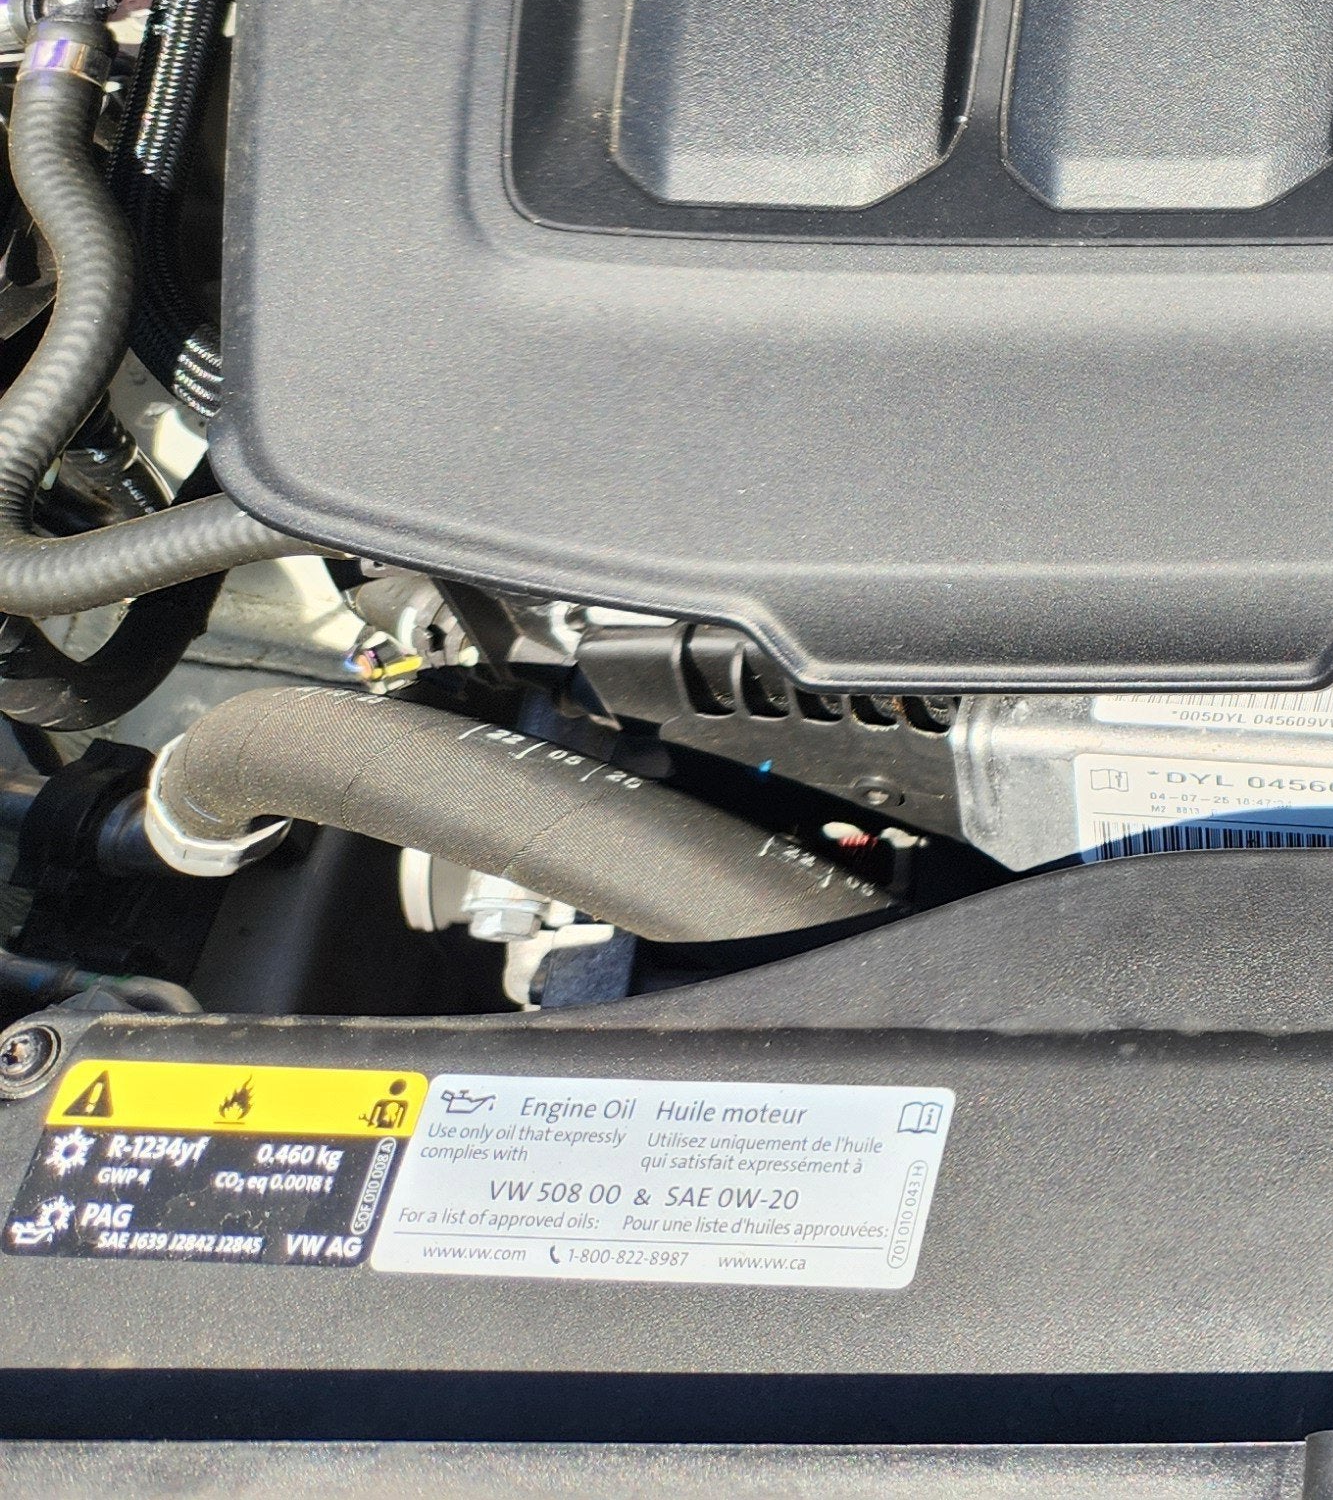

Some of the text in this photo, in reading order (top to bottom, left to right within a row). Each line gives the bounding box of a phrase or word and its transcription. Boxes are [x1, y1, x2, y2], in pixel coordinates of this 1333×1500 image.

[520, 1096, 636, 1123] Engine Oil
[656, 1099, 808, 1125] Huile moteur
[381, 1141, 394, 1152] A
[428, 1123, 627, 1148] Use only oil that expressly
[647, 1131, 883, 1158] Utilisez uniquement de l'huile
[107, 1135, 344, 1171] R-1234yf 0.460 kg
[420, 1143, 528, 1163] complies with
[641, 1154, 863, 1176] qui satisfait expressément à
[98, 1168, 137, 1185] GWP
[139, 1169, 153, 1185] 4
[247, 1176, 268, 1193] eq
[269, 1172, 321, 1192] 0.0018
[323, 1175, 334, 1192] t
[490, 1180, 652, 1206] VW 508 00 &
[664, 1186, 799, 1210] SAE 0W-20
[80, 1203, 134, 1228] PAG
[399, 1207, 600, 1231] For a list of approved oils:
[891, 1165, 924, 1263] 701 010 043 H
[623, 1215, 888, 1241] Pour une liste d'huiles approuvées:
[98, 1232, 129, 1249] SAE
[285, 1235, 363, 1257] VW AG
[422, 1246, 526, 1262] www.vw.com
[567, 1247, 689, 1268] 1-800-822-8987
[718, 1254, 807, 1270] www.vw.ca
